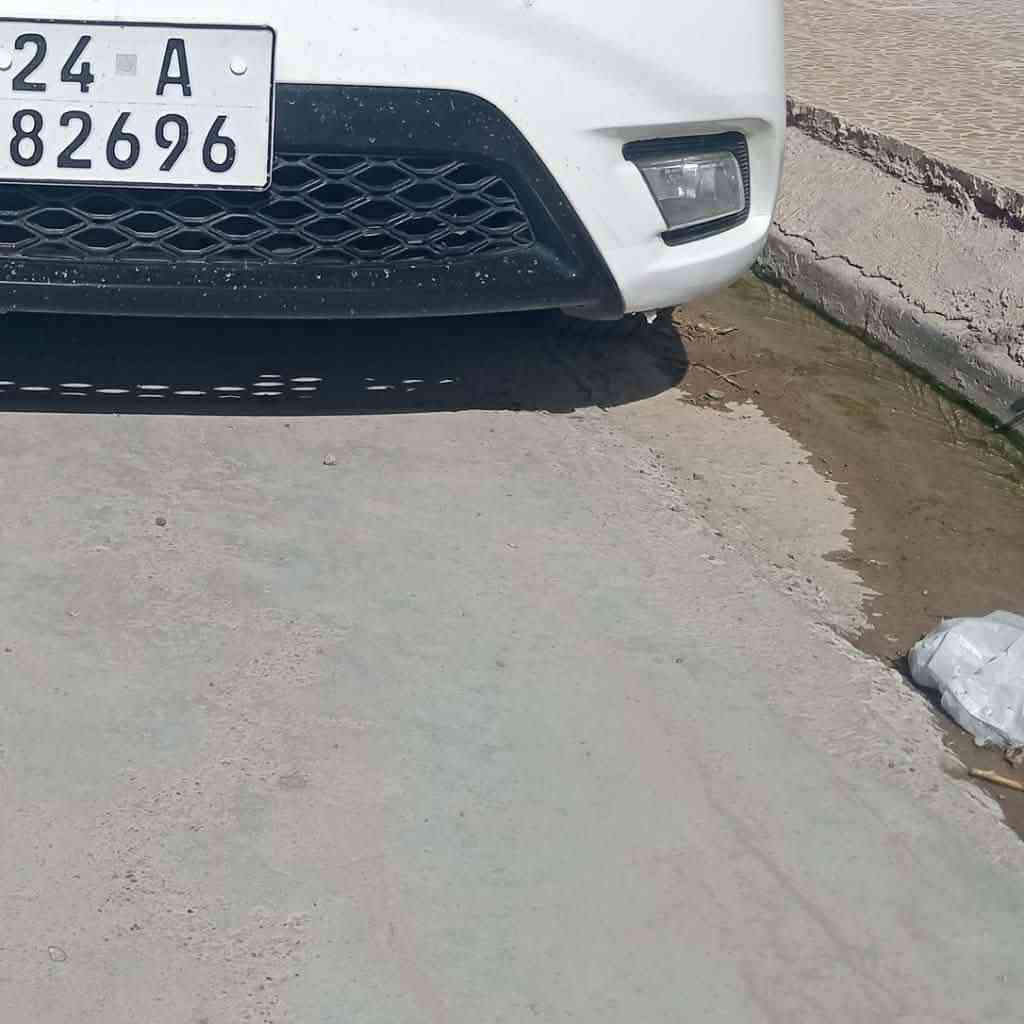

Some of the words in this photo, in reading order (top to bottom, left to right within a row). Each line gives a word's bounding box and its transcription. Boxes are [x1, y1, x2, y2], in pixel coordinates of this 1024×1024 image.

[12, 33, 95, 93] 24
[155, 37, 193, 97] A
[9, 108, 237, 173] 82696
